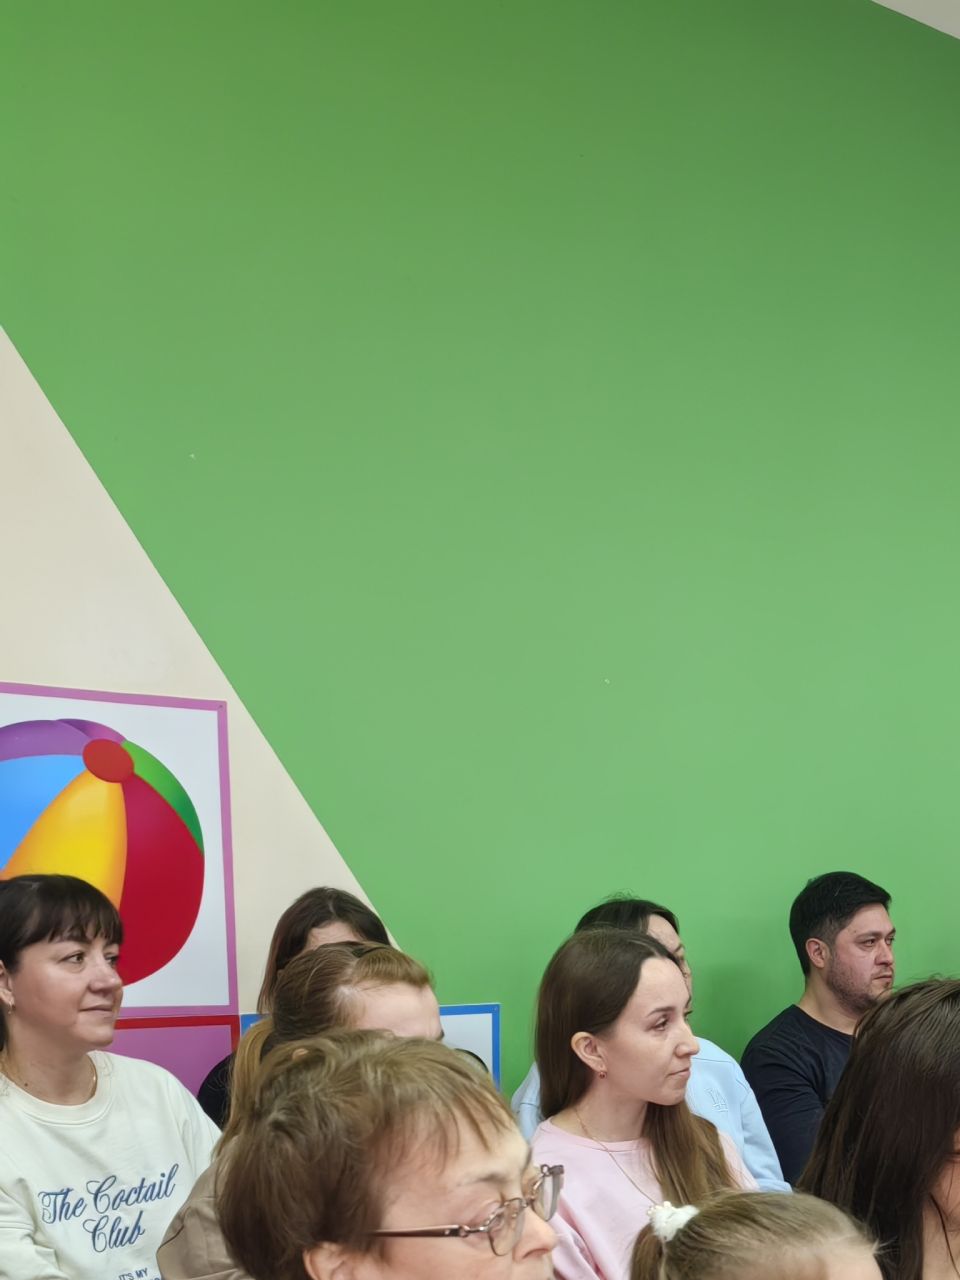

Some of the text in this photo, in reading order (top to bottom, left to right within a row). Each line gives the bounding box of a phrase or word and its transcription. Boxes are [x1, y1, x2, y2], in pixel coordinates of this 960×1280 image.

[38, 1163, 179, 1224] The Coctail
[82, 1210, 146, 1253] Club
[135, 1267, 148, 1279] MY
